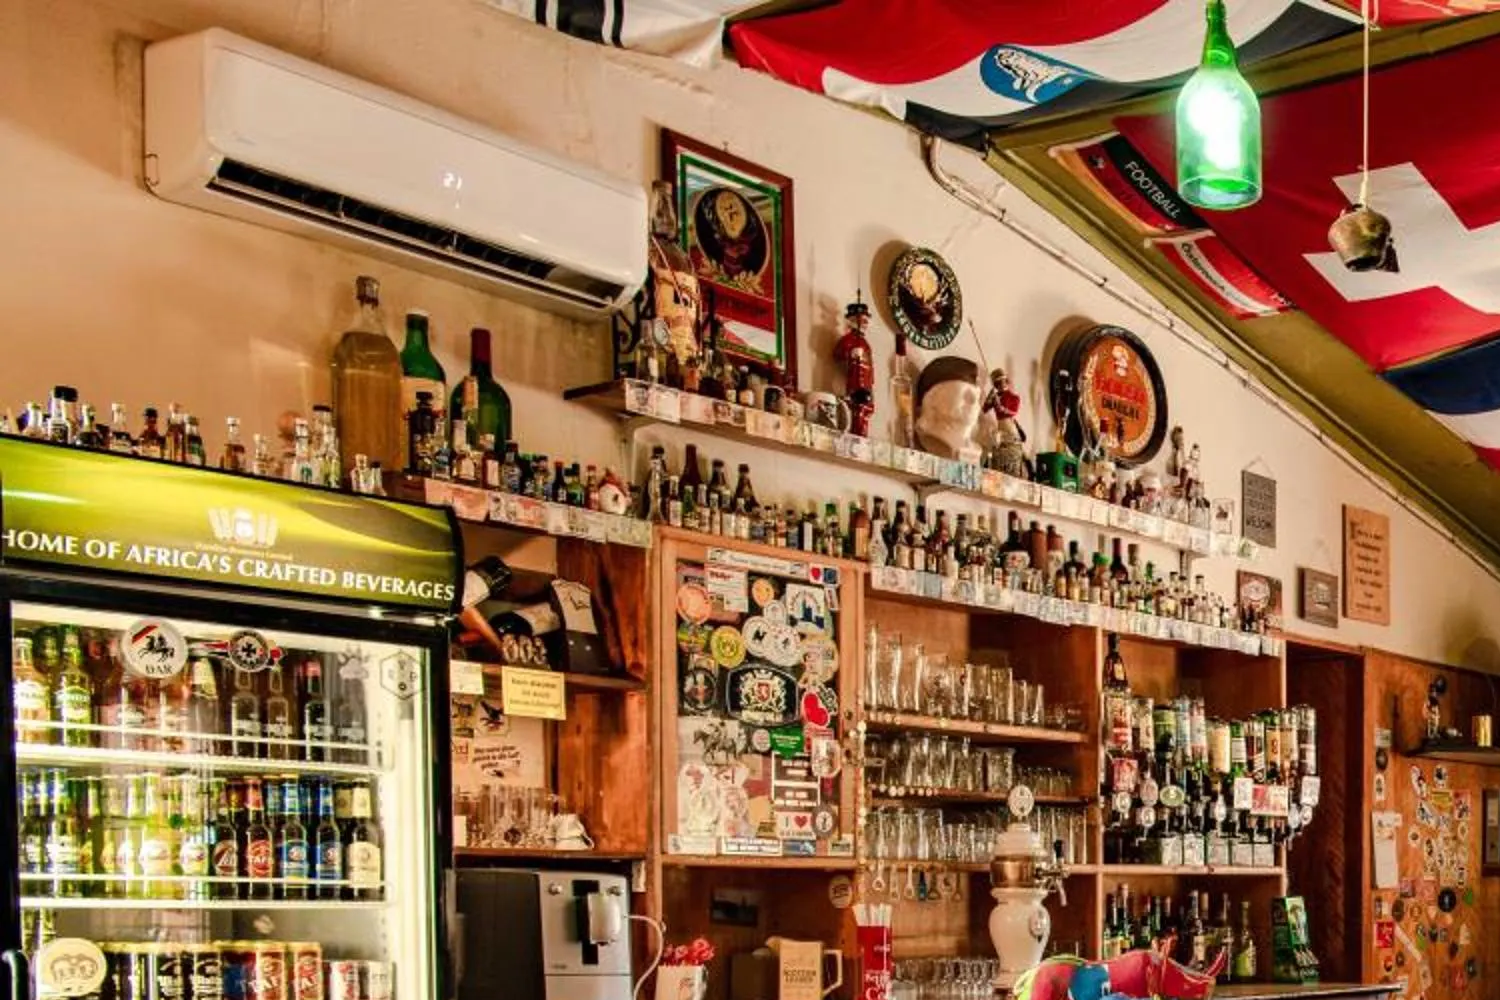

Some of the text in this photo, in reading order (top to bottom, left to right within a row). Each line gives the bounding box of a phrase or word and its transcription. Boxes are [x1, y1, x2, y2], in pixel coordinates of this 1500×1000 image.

[1124, 160, 1182, 219] FOOTBALL
[2, 528, 79, 556] HOME
[85, 538, 122, 560] OF
[126, 542, 232, 574] AFRICA'S
[237, 557, 337, 587] CRAFTED
[341, 570, 456, 602] BEVERAGES
